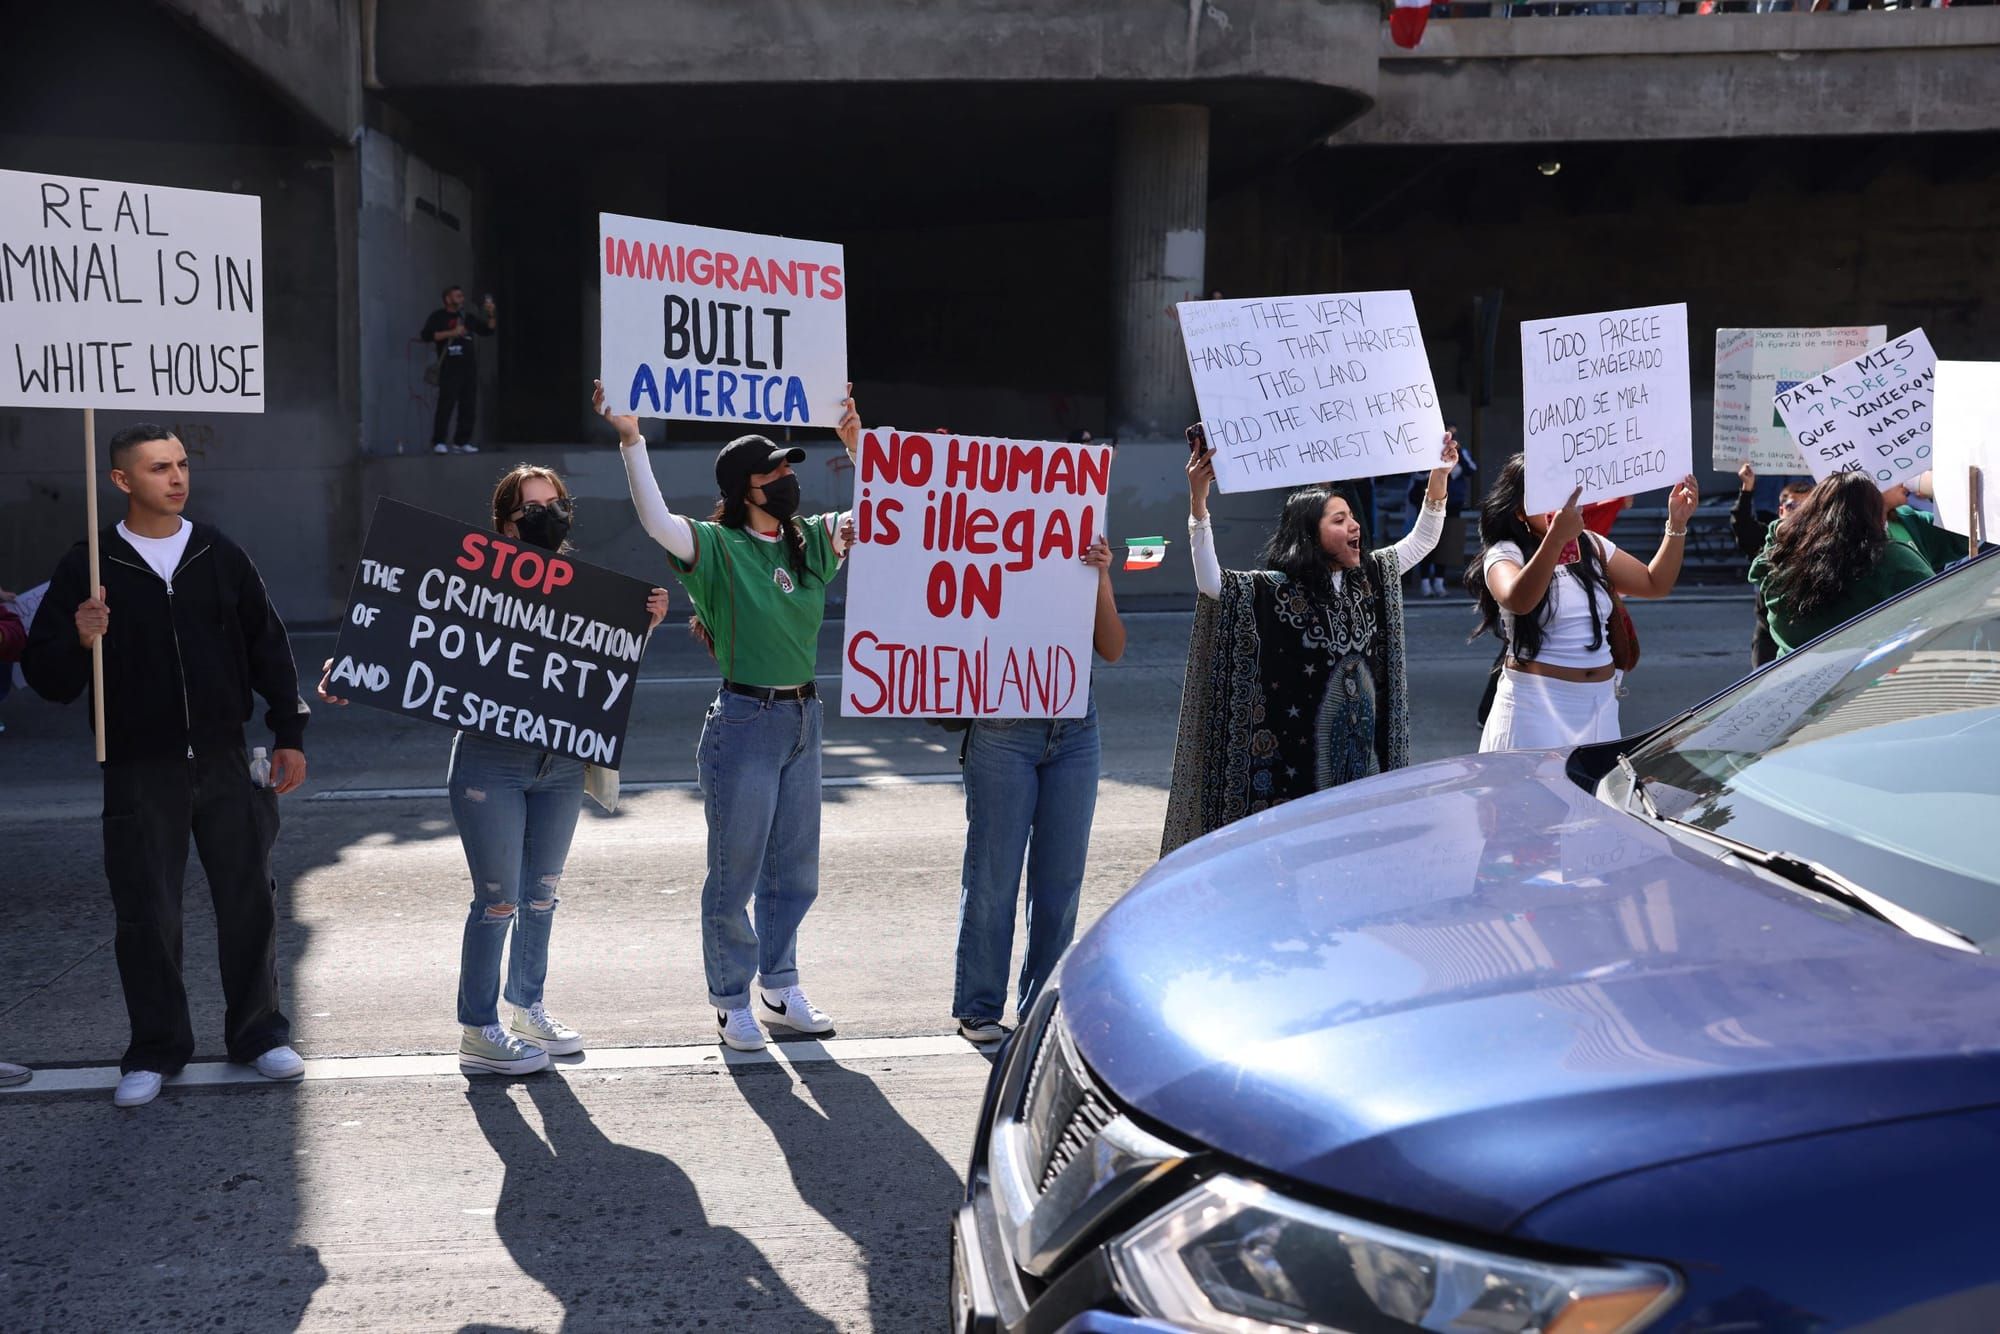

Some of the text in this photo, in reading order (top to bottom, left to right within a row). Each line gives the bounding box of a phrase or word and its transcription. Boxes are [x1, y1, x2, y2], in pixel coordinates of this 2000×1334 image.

[41, 182, 169, 236] REAL
[0, 243, 253, 313] MINAL IS IN
[606, 237, 843, 300] IMMIGRANTS
[663, 294, 790, 370] BUILT
[1240, 302, 1299, 329] THE
[1306, 298, 1365, 327] VERY
[1538, 316, 1662, 364] TODO PARECE
[15, 342, 261, 397] WHITE HOUSE
[1190, 326, 1417, 373] HANDS THAT HARVEST
[1578, 348, 1663, 380] EXAGERADO
[1774, 339, 1914, 412] PARA MIS
[630, 363, 810, 423] AMERICA
[1249, 360, 1367, 400] THIS LAND
[1798, 368, 1934, 447] QUE VINIERON
[1808, 364, 1908, 417] PADRES
[1207, 383, 1434, 449] HOLD THE VERY HEARTS
[1528, 383, 1649, 436] CUANDO SE MIRA
[1820, 400, 1927, 462] SIN NADA
[861, 432, 1110, 496] NO HUMAN
[1233, 422, 1425, 475] THAT HARVEST ME
[1562, 416, 1644, 463] DESDE EL
[1877, 421, 1932, 457] DIERO
[1877, 445, 1931, 481] ODO
[1575, 449, 1666, 491] PRIVILEGIO
[456, 533, 574, 594] STOP
[927, 560, 1002, 619] ON
[361, 559, 643, 662] THE CRIMINALIZATION
[352, 603, 629, 711] OF POVERTY
[330, 655, 616, 763] AND DESPERATION
